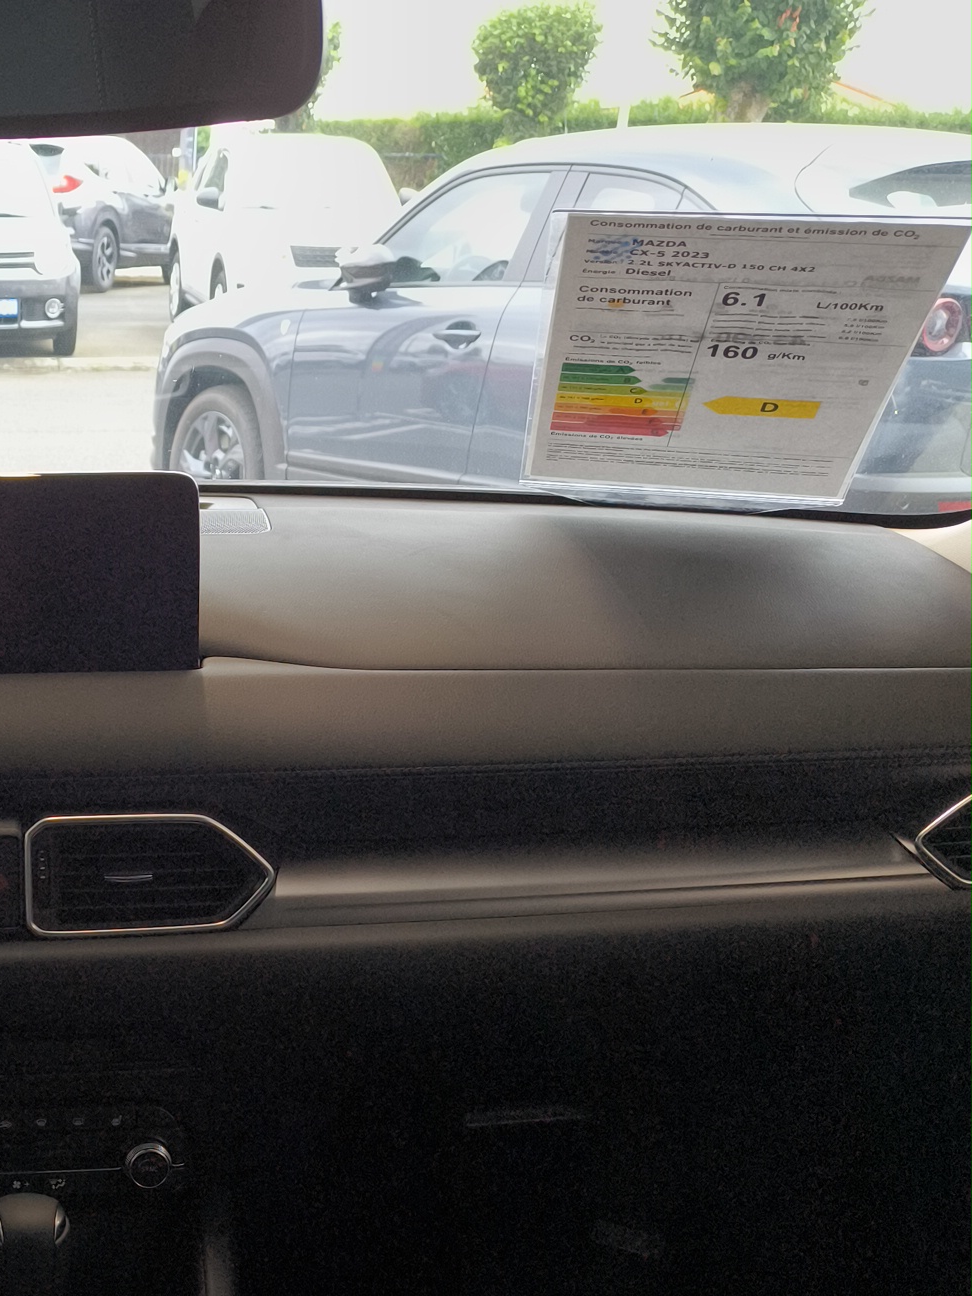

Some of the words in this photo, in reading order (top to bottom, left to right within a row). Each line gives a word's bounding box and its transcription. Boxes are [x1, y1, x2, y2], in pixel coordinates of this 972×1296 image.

[590, 219, 691, 231] Consommation
[696, 222, 713, 231] de
[717, 224, 783, 234] carburant
[804, 227, 867, 237] émission
[871, 229, 889, 237] de
[632, 238, 687, 248] MAZDA
[630, 249, 666, 258] CX-5
[671, 250, 710, 259] 2023
[625, 267, 671, 277] Diesel
[658, 261, 737, 270] SKYACTIV-D
[741, 263, 765, 271] 150
[790, 265, 816, 273] 4X2
[579, 285, 693, 297] Consommation
[577, 295, 595, 303] de
[599, 296, 672, 306] carburant
[721, 291, 767, 307] 6.1
[816, 301, 885, 312] L/100Km
[707, 343, 759, 360] 160
[767, 352, 806, 361] g/Km
[760, 401, 779, 413] D
